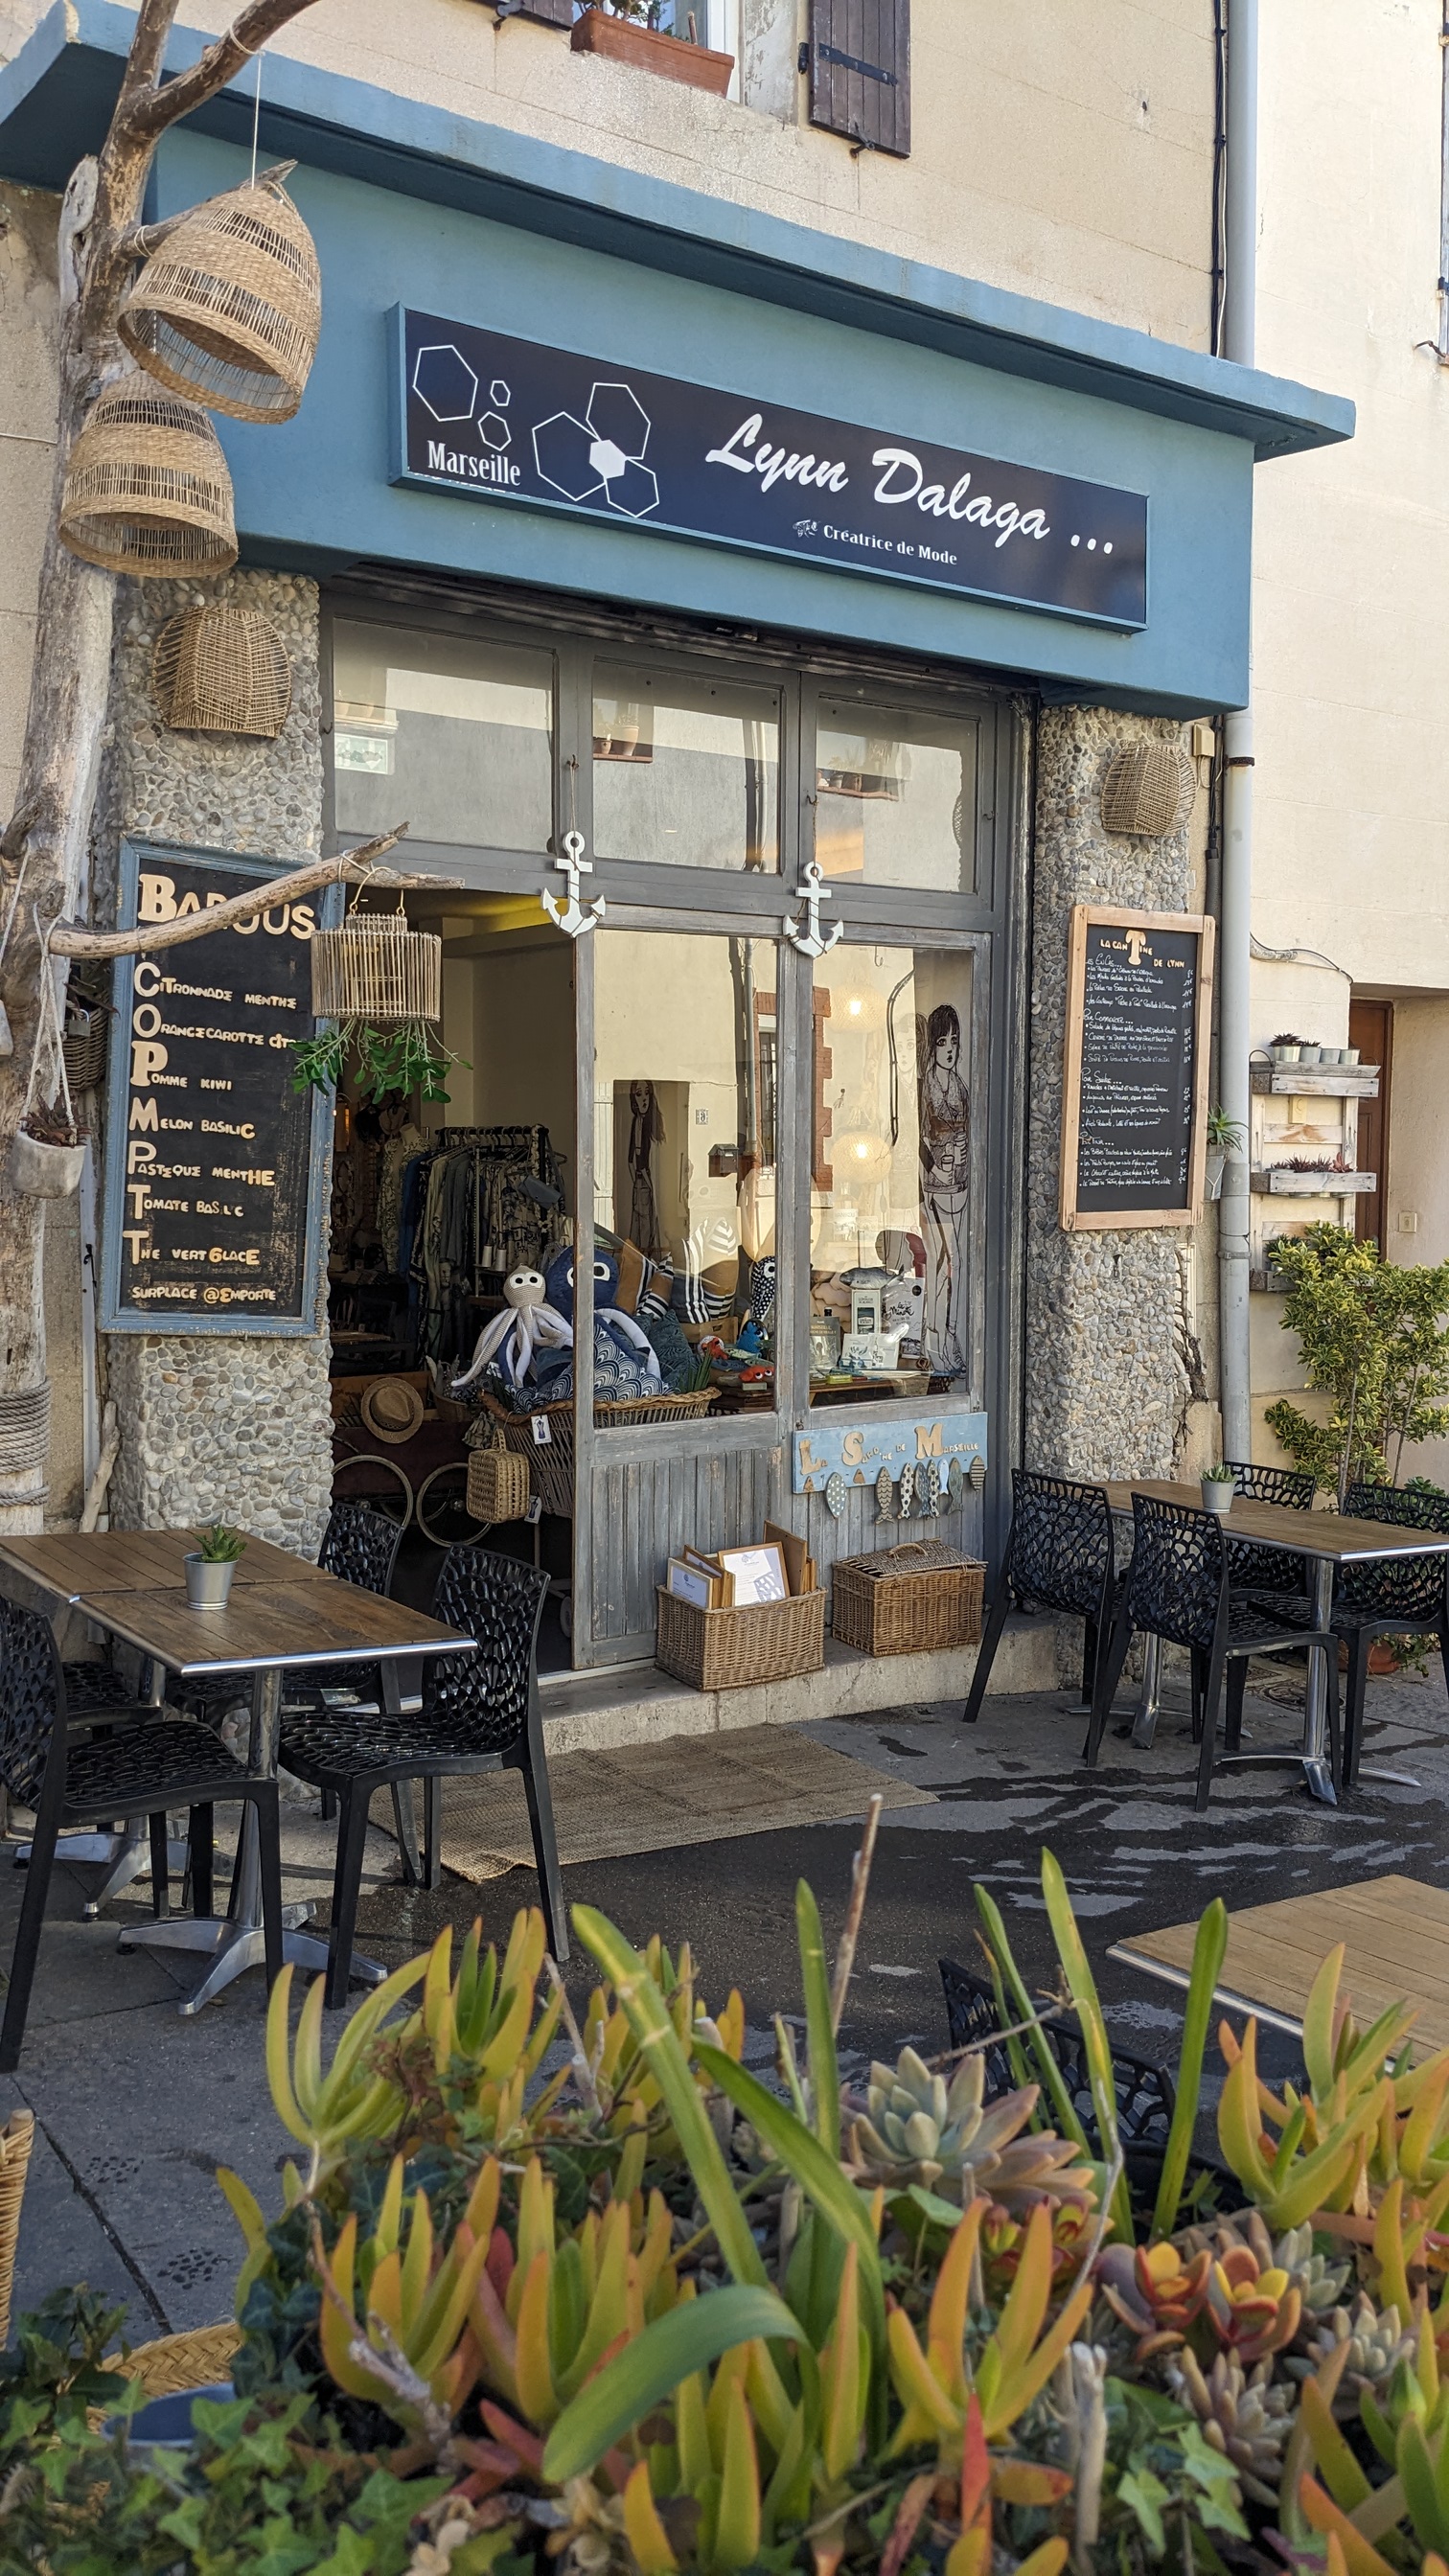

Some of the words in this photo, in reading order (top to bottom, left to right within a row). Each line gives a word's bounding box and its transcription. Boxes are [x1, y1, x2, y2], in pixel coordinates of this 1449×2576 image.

[427, 440, 521, 486] Marseille
[705, 413, 849, 493] Lynn
[872, 448, 1050, 548] Dalaga
[823, 524, 893, 552] Créatrice
[897, 540, 914, 556] de
[918, 544, 957, 565] Mode
[1100, 939, 1111, 949] LA
[1153, 958, 1163, 968] DE
[1166, 959, 1185, 969] LYNN
[243, 993, 298, 1010] MENTHE
[205, 1026, 265, 1046] CAROTTE
[129, 1040, 189, 1089] POMME
[200, 1078, 233, 1091] KIWI
[128, 1096, 194, 1132] MELON
[200, 1119, 256, 1139] BASILIC
[126, 1140, 201, 1179] PASTEQUE
[212, 1166, 276, 1186] MENTHE
[126, 1184, 190, 1220] TOMATE
[196, 1200, 244, 1218] BASLC
[172, 1249, 207, 1261] VERT
[840, 1431, 893, 1467] SARDNE
[896, 1442, 907, 1453] DE
[913, 1422, 979, 1460] MARSEILLE
